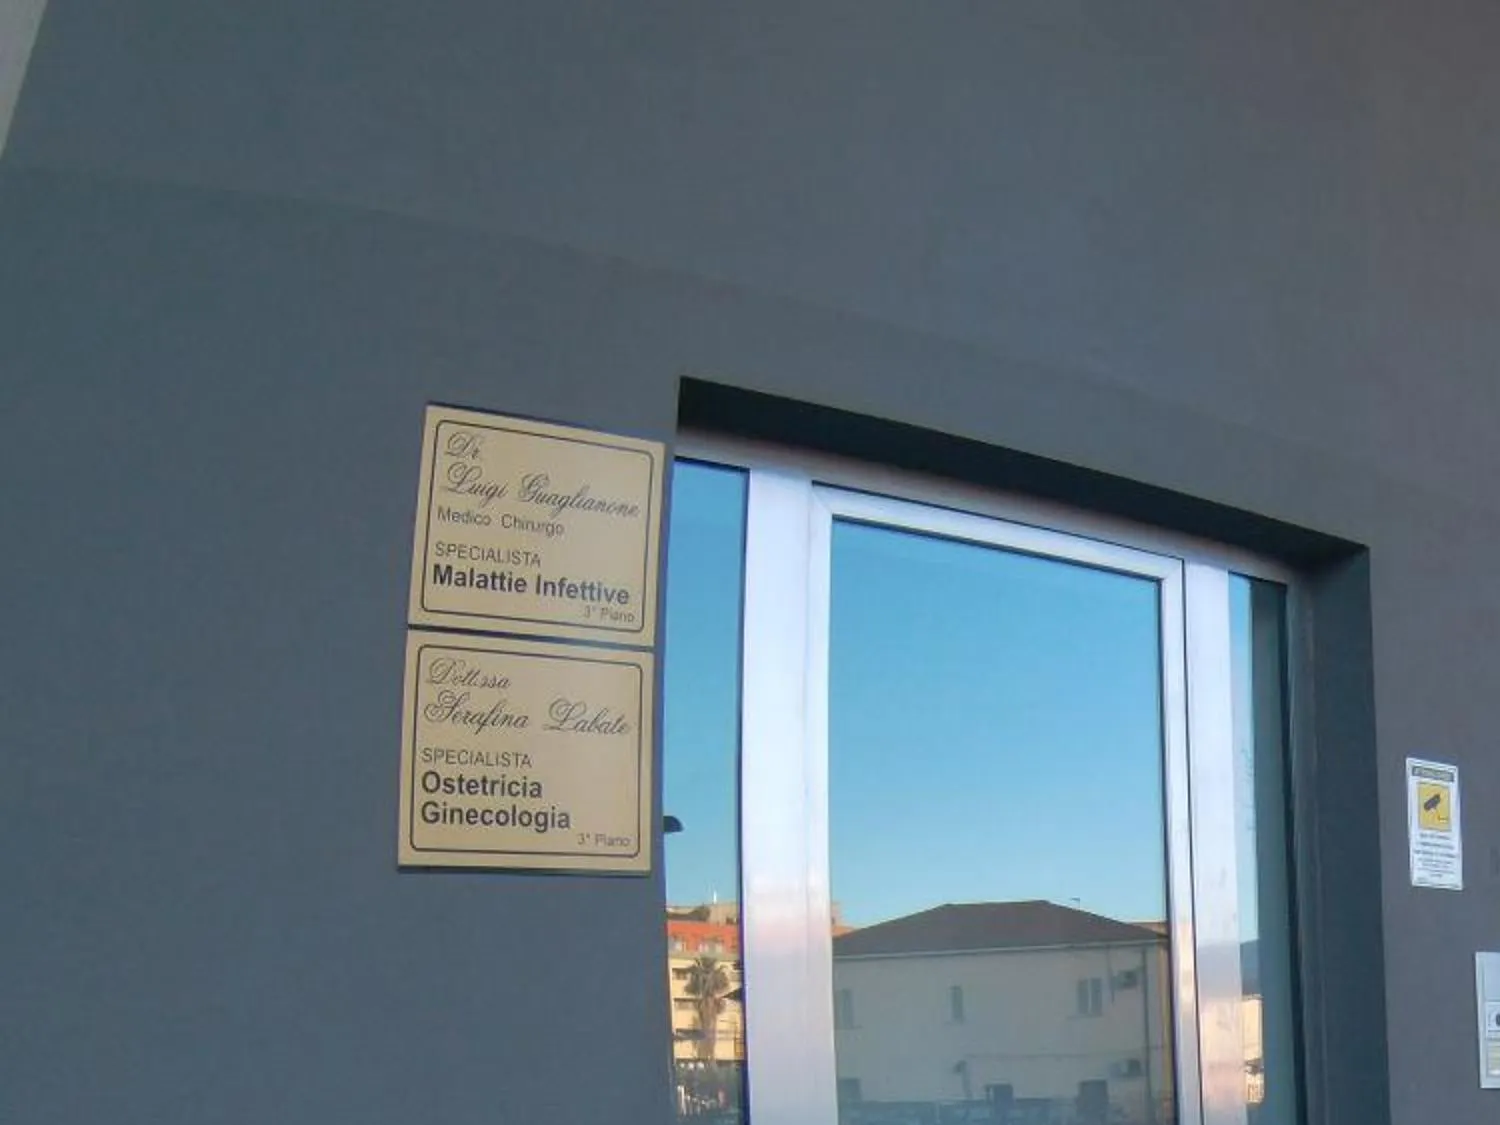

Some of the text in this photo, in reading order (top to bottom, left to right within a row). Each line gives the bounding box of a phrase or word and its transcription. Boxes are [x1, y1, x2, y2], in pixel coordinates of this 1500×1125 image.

[441, 461, 508, 508] Luigi
[437, 506, 565, 537] Medico Chirurgo
[434, 541, 541, 568] SPECIALISTA
[432, 563, 630, 605] Malattie Infettive
[601, 607, 635, 623] Piano
[424, 689, 629, 735] Serafina Labate
[421, 747, 533, 769] SPECIALISTA
[421, 771, 543, 799] Ostetricia
[421, 801, 571, 834] Ginecologia
[595, 833, 631, 848] Piano
